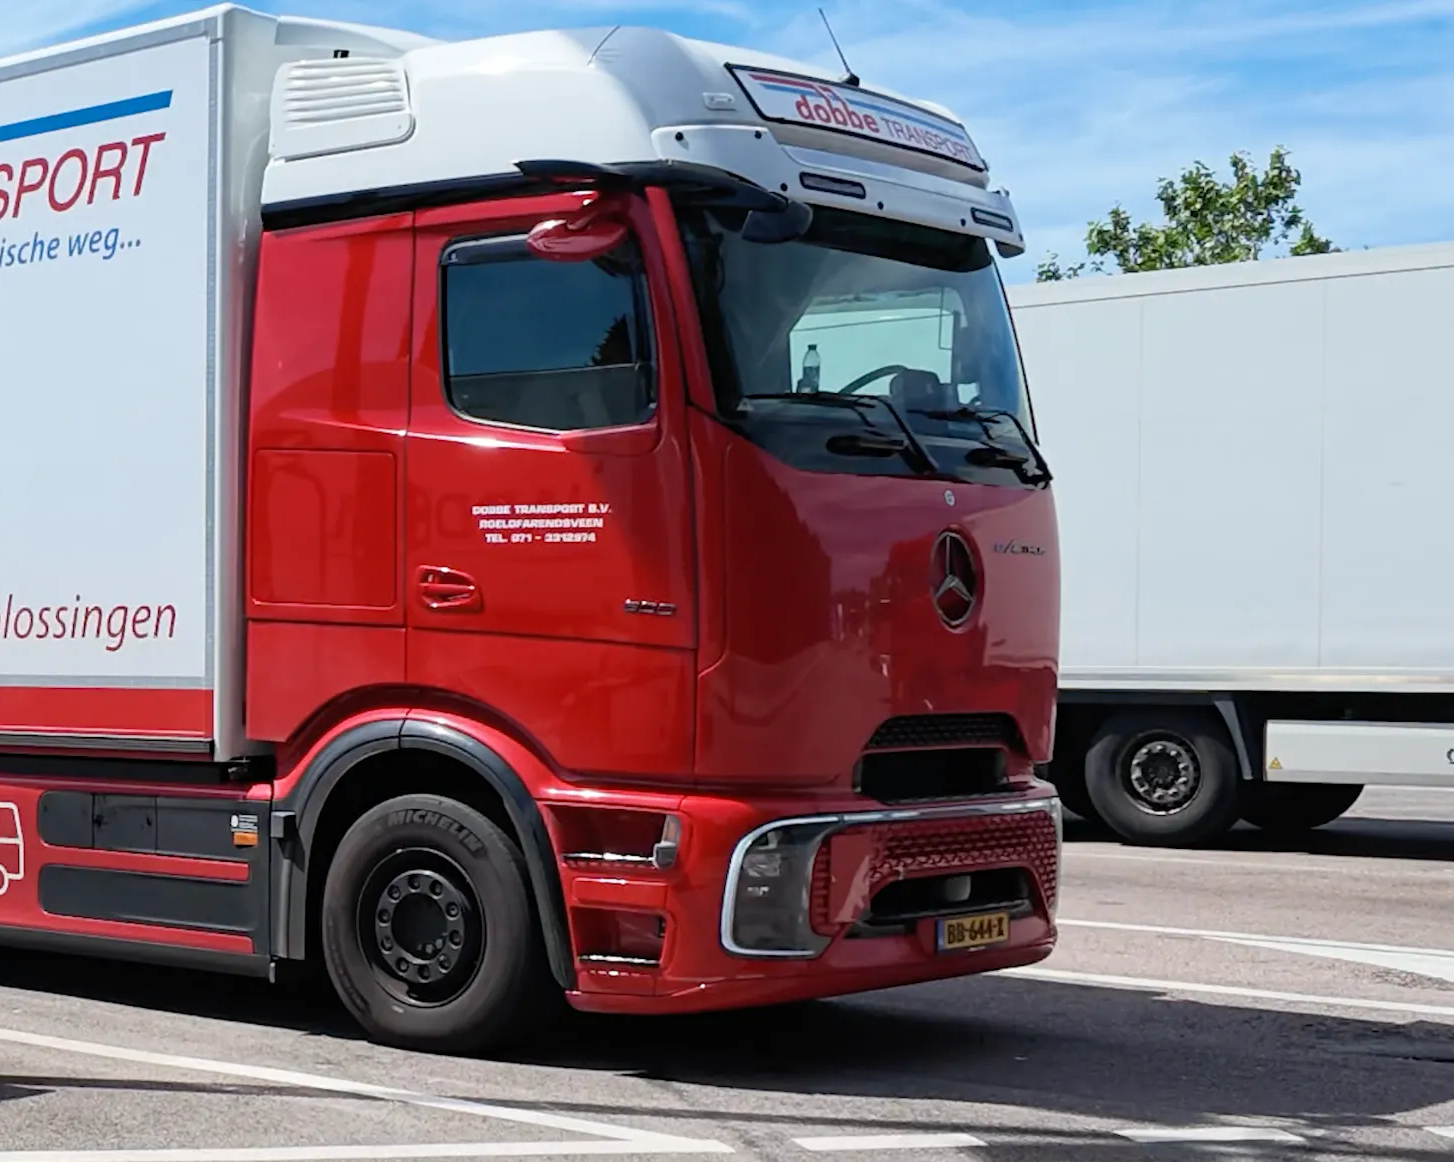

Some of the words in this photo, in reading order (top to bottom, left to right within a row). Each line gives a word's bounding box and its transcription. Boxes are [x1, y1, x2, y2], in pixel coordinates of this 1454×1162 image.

[795, 88, 879, 133] dobbe
[881, 116, 973, 160] TRANSPORT
[67, 226, 142, 262] weg...
[514, 503, 585, 514] TRANSPORT
[588, 503, 613, 514] B.V.
[485, 533, 508, 543] TEL.
[511, 533, 532, 543] 071
[386, 808, 487, 853] MICHELIN
